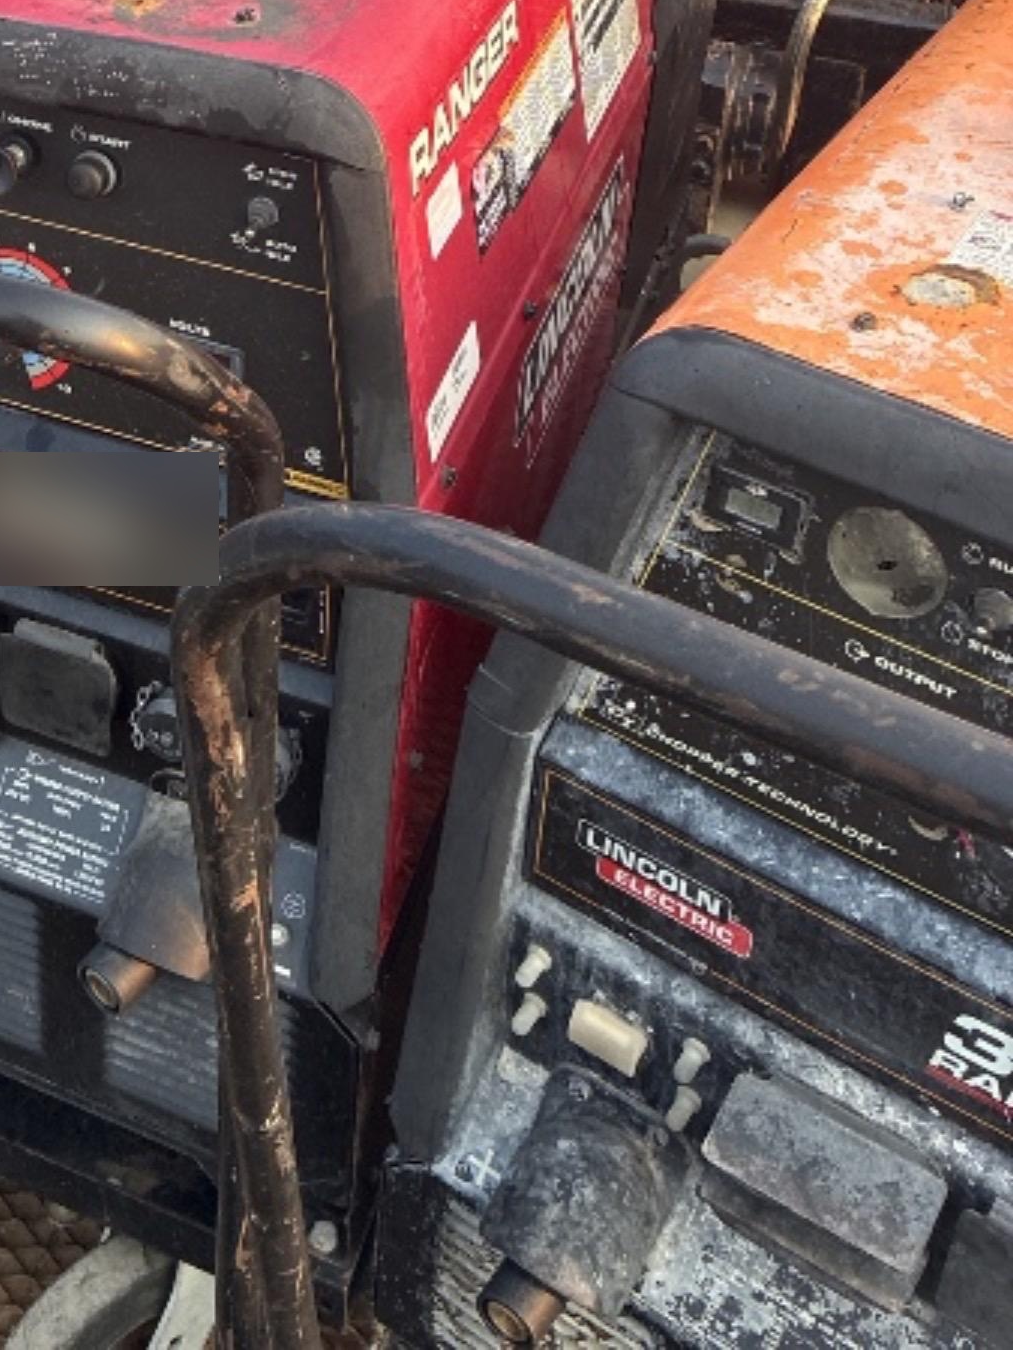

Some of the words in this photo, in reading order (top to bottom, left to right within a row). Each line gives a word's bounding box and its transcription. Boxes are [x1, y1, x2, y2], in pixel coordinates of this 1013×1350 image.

[874, 655, 958, 699] OUTPUT
[585, 827, 721, 916] LINCOLN
[613, 869, 734, 946] ELECTRIC
